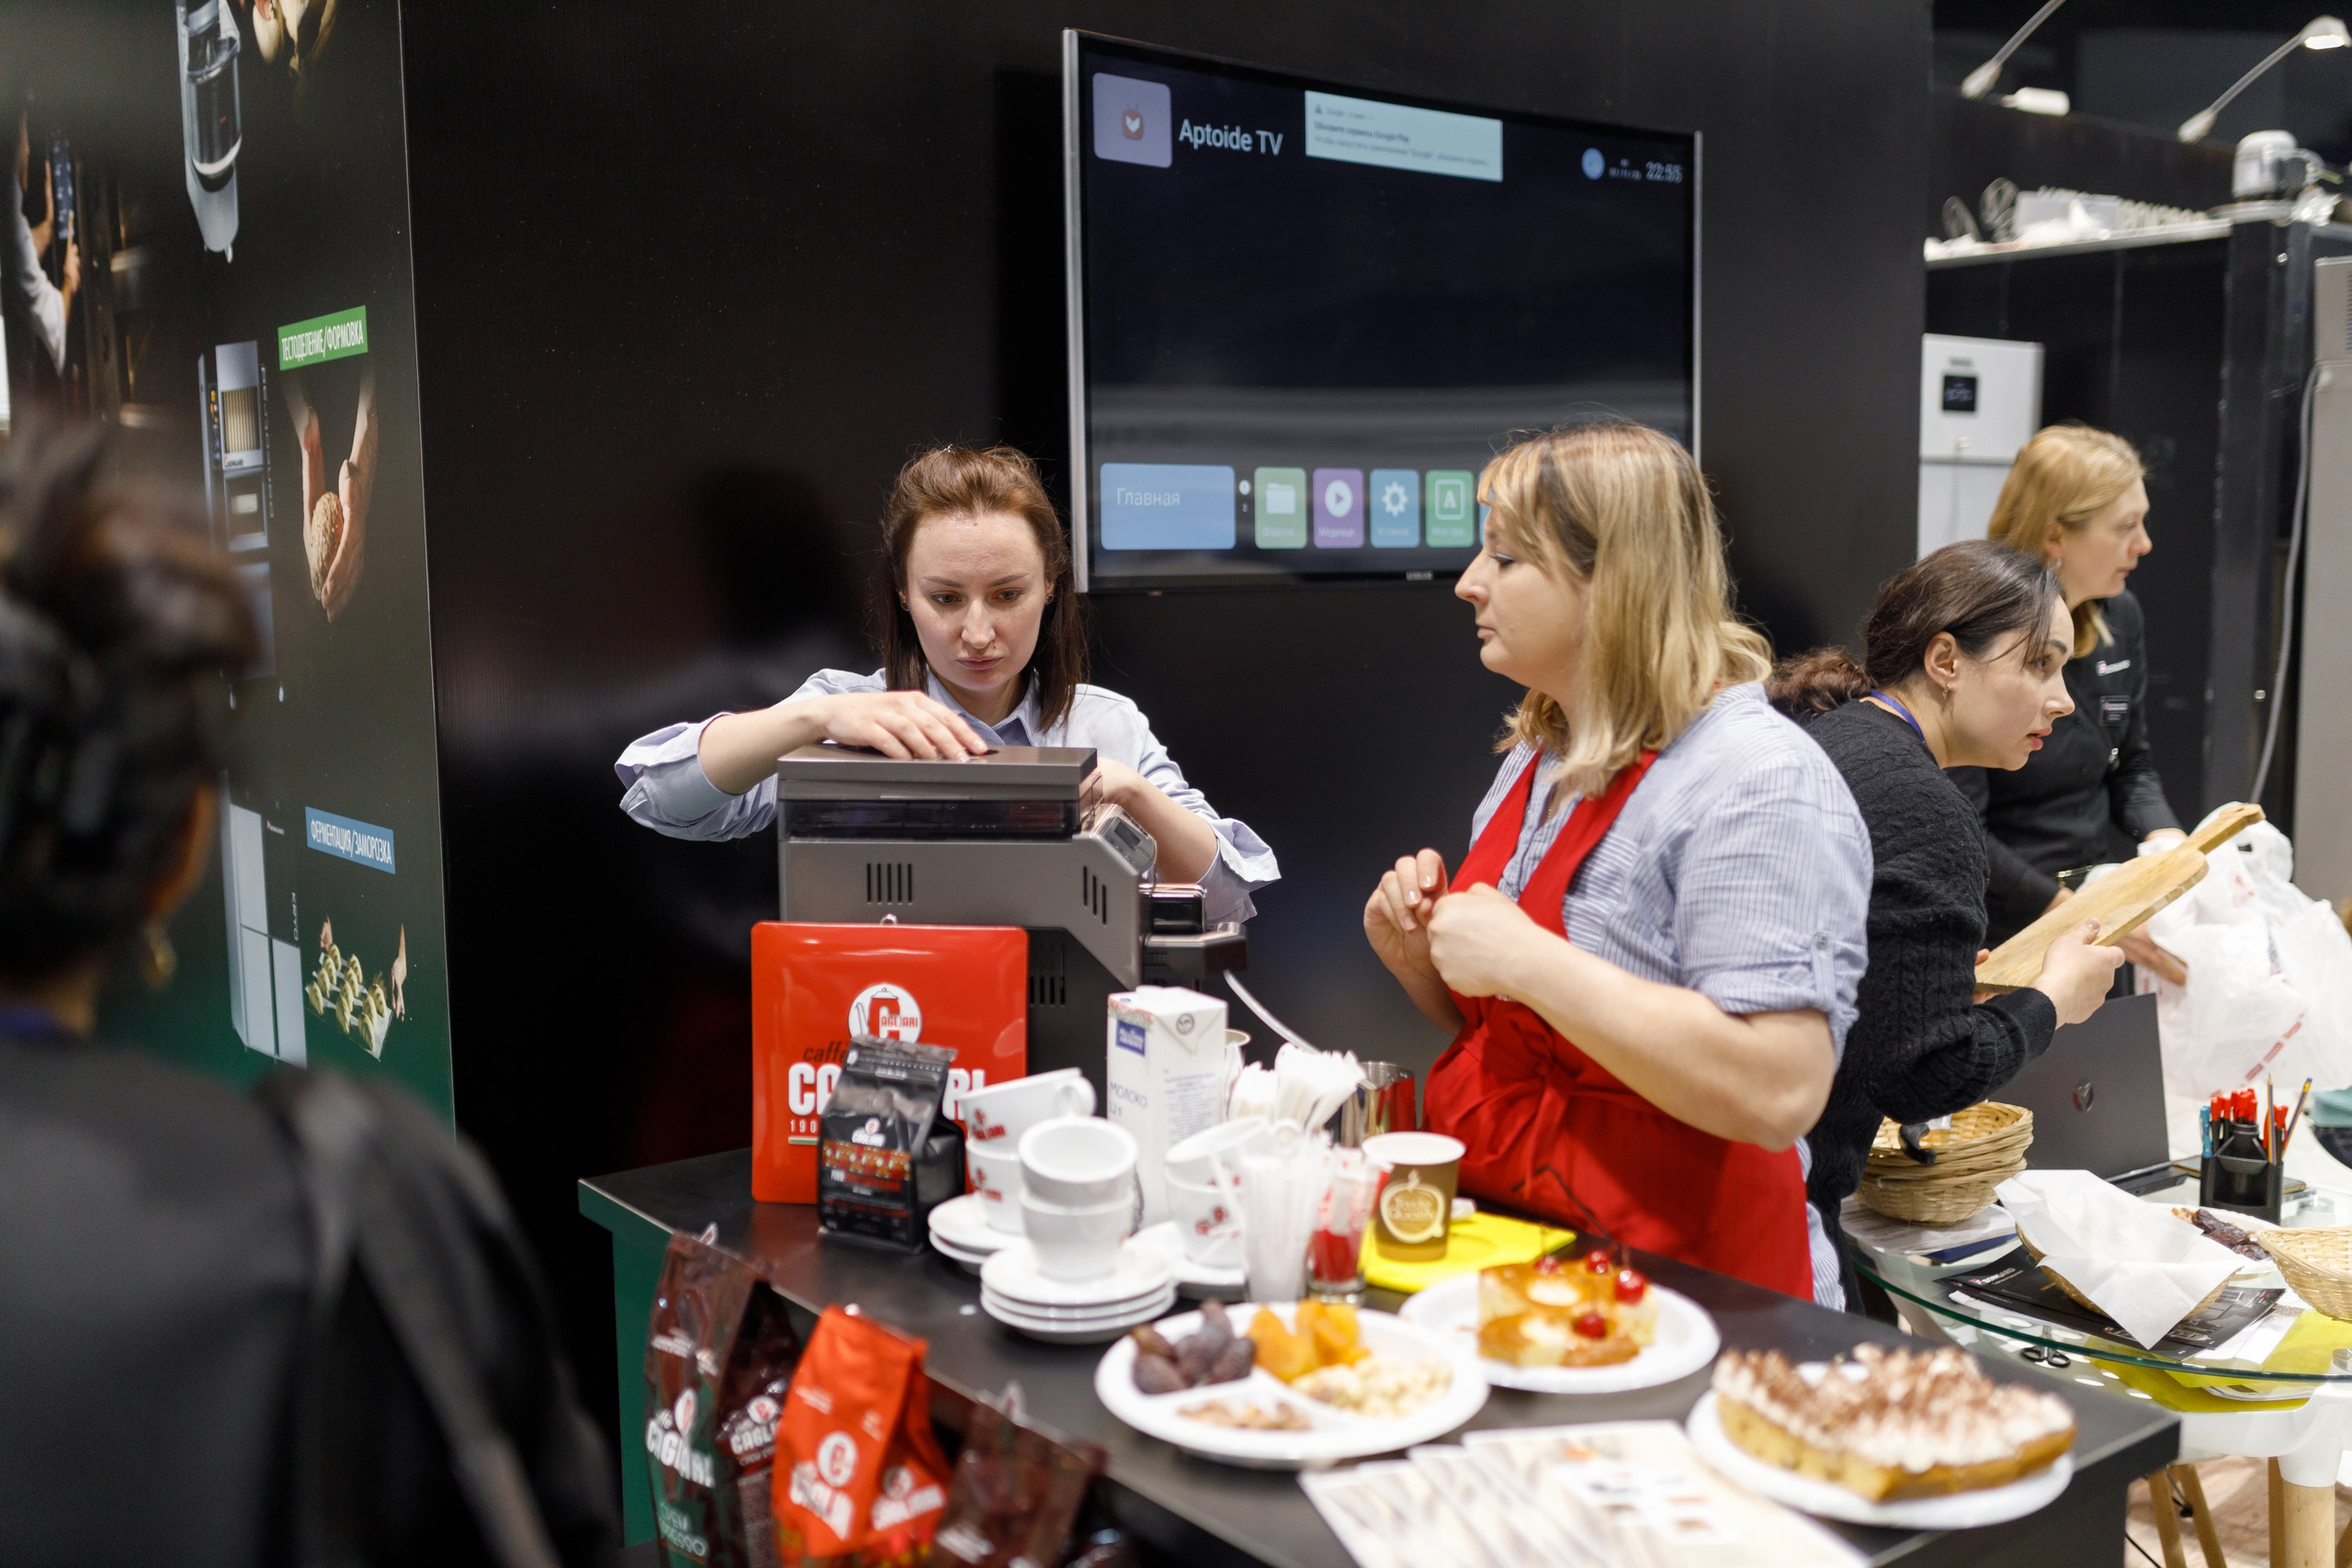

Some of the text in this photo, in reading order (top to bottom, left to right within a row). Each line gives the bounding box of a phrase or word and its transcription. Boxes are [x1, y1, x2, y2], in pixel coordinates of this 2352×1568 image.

[1179, 118, 1283, 156] Aptoide TV
[1116, 487, 1181, 506] Главная
[1110, 1081, 1148, 1110] МОЛОКО
